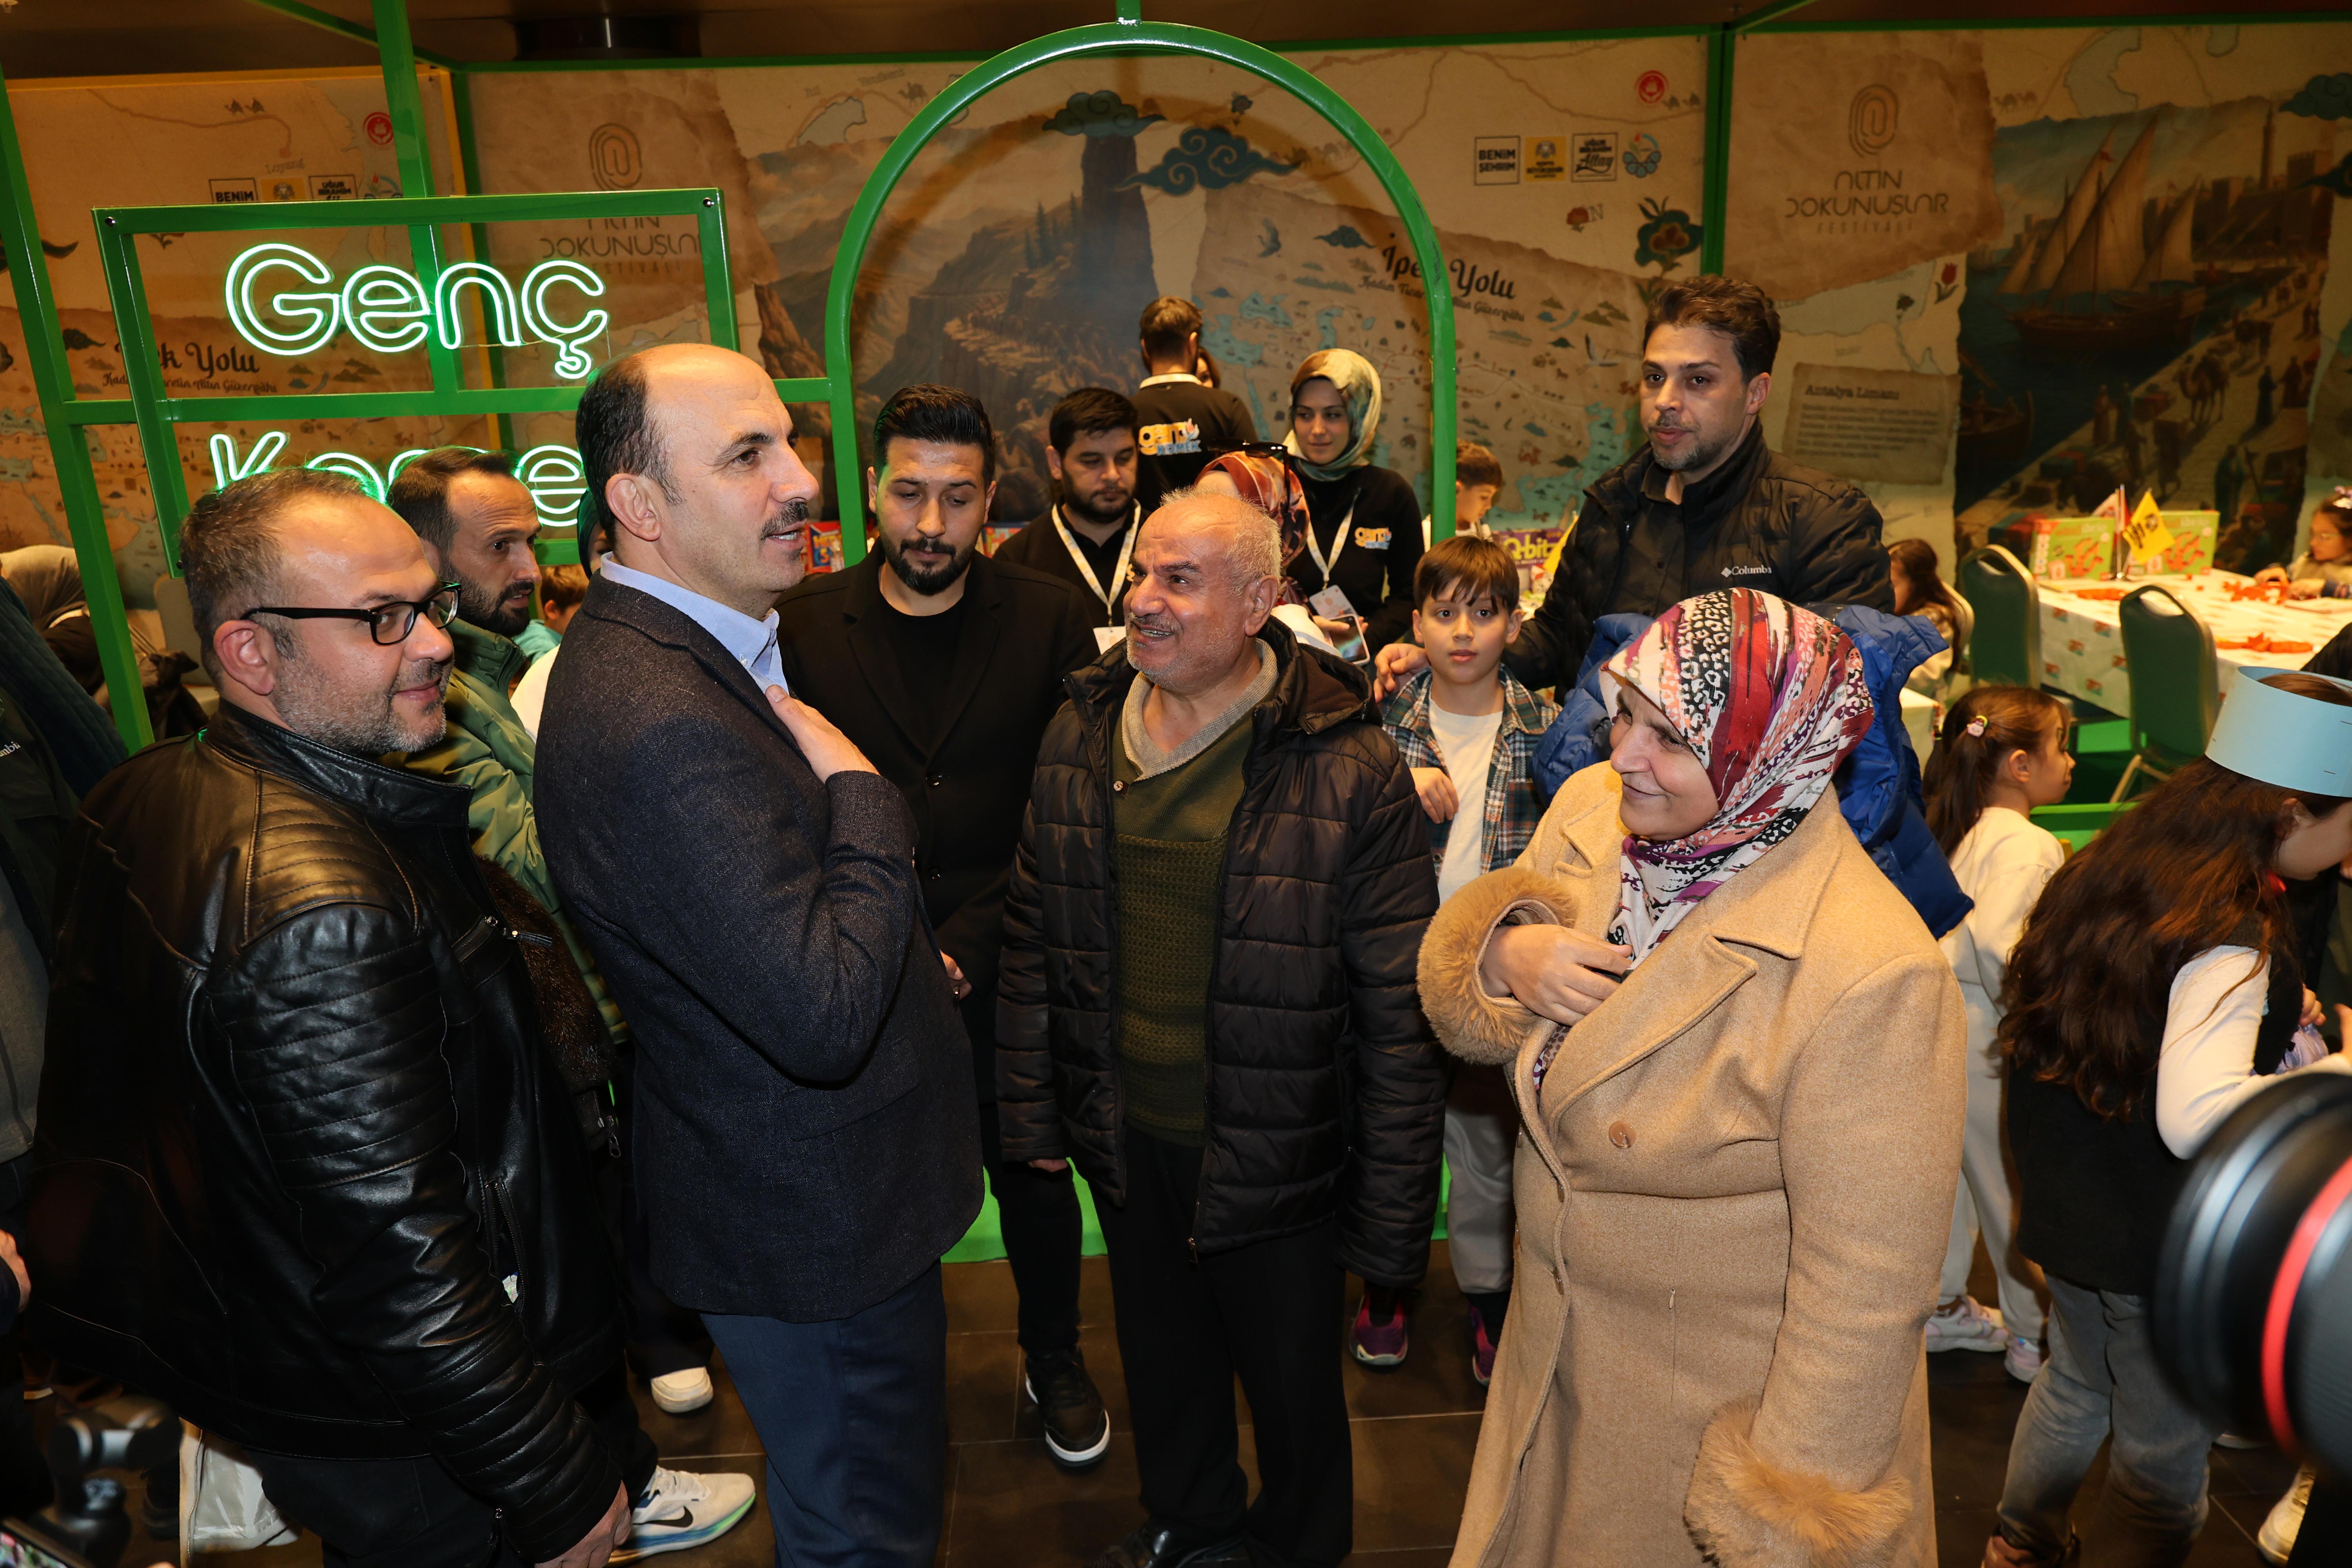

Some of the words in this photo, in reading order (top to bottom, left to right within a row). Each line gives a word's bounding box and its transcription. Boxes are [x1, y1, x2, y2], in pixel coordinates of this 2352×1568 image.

[215, 190, 254, 202] BENİM
[539, 233, 701, 259] DOKUNUŞLA
[1382, 232, 1423, 280] İpe
[1450, 258, 1516, 299] Yolu
[225, 243, 609, 379] Genç
[185, 342, 260, 379] Yolu
